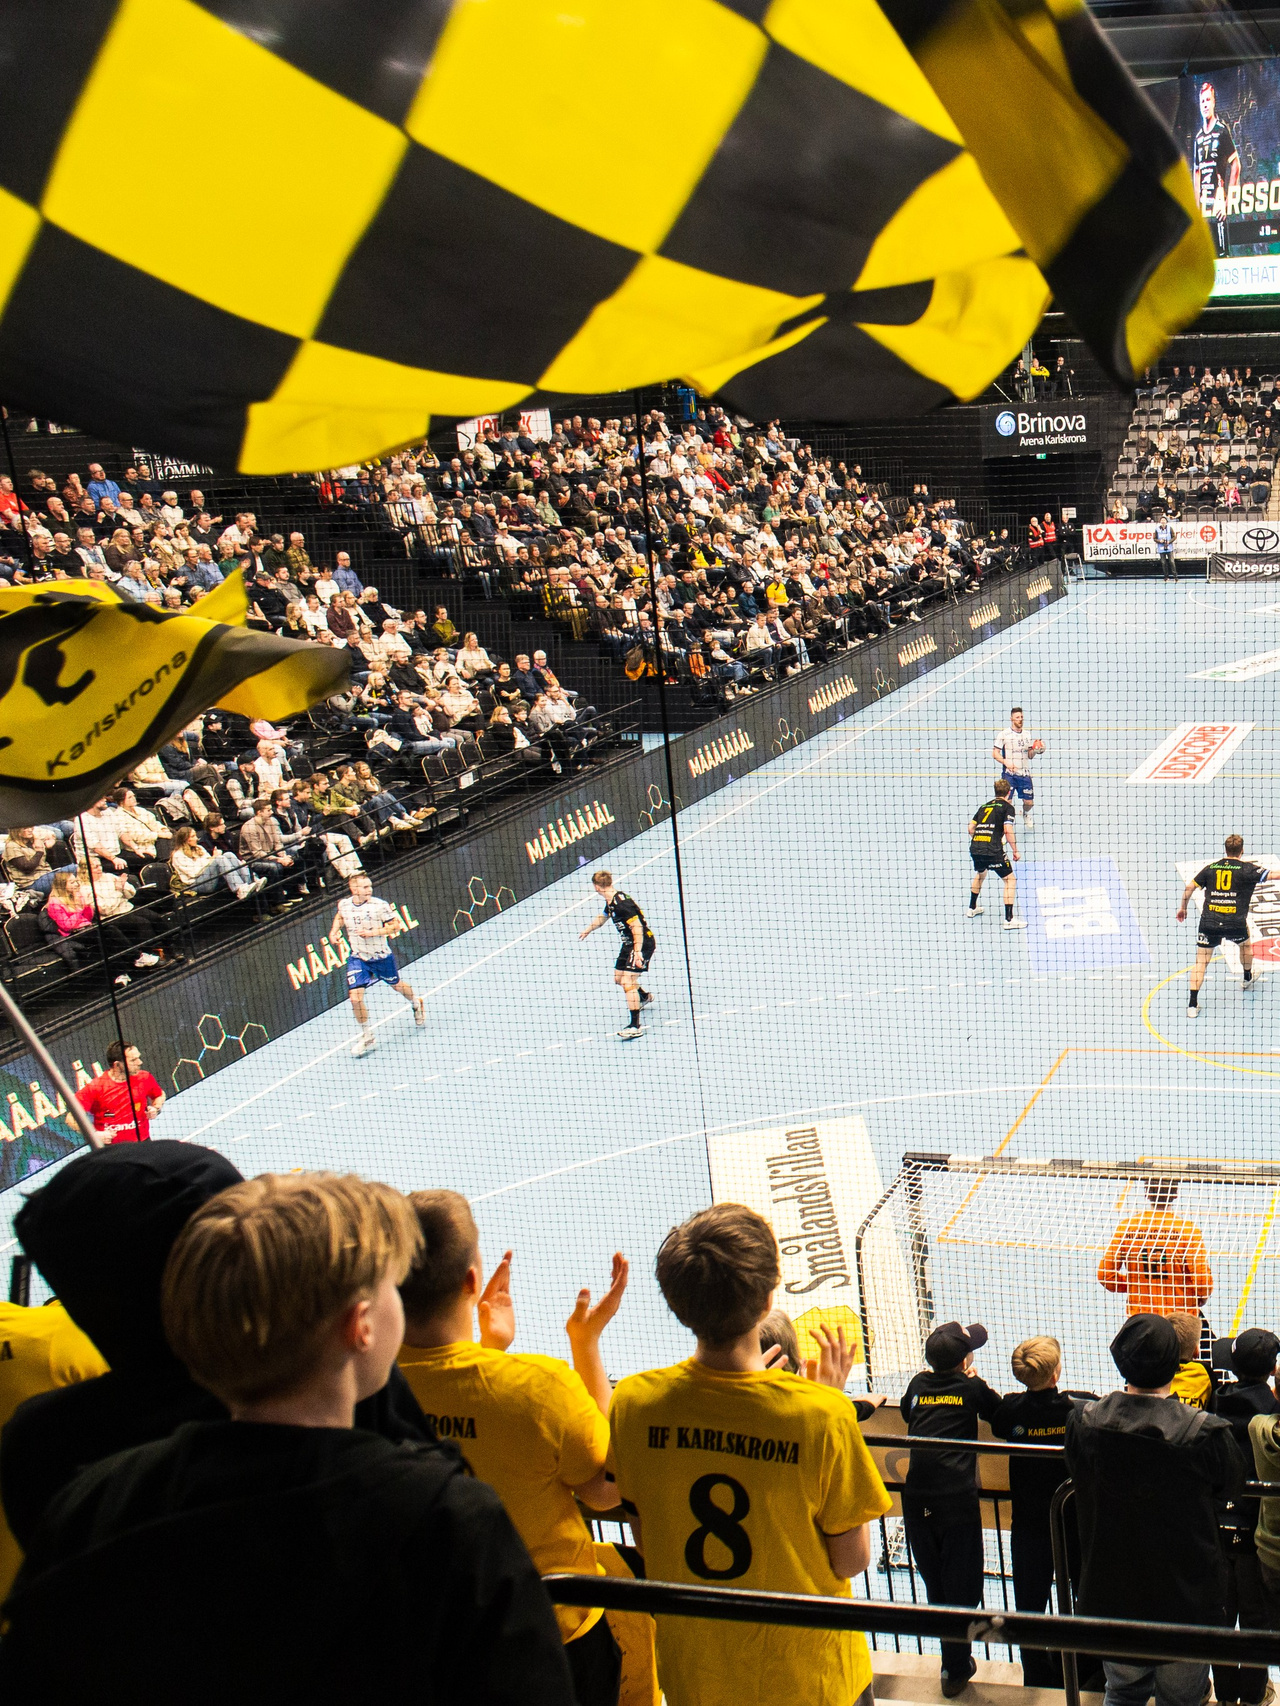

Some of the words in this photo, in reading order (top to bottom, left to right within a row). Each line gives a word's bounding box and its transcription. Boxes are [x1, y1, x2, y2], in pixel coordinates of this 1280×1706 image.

[1243, 265, 1278, 284] THAT
[1018, 412, 1086, 434] Brinova
[1020, 436, 1044, 446] Arena
[1045, 434, 1086, 445] Karlskrona
[1087, 528, 1115, 543] ICA
[1119, 527, 1197, 543] Superket
[1089, 542, 1151, 557] Jämjöhallen
[1224, 561, 1280, 575] Råbergs
[46, 650, 188, 776] Karlskrona
[1153, 725, 1231, 779] UDDCOMB
[982, 807, 994, 823] 7
[1215, 869, 1232, 891] 10
[1036, 886, 1120, 939] BLT
[766, 1126, 852, 1295] SmålandsVillan
[918, 1394, 964, 1407] KARLSKRONA
[1028, 1425, 1066, 1438] KARLSKRO
[648, 1425, 670, 1449] HF
[676, 1426, 800, 1465] KARLSKRONA
[684, 1472, 753, 1581] 8
